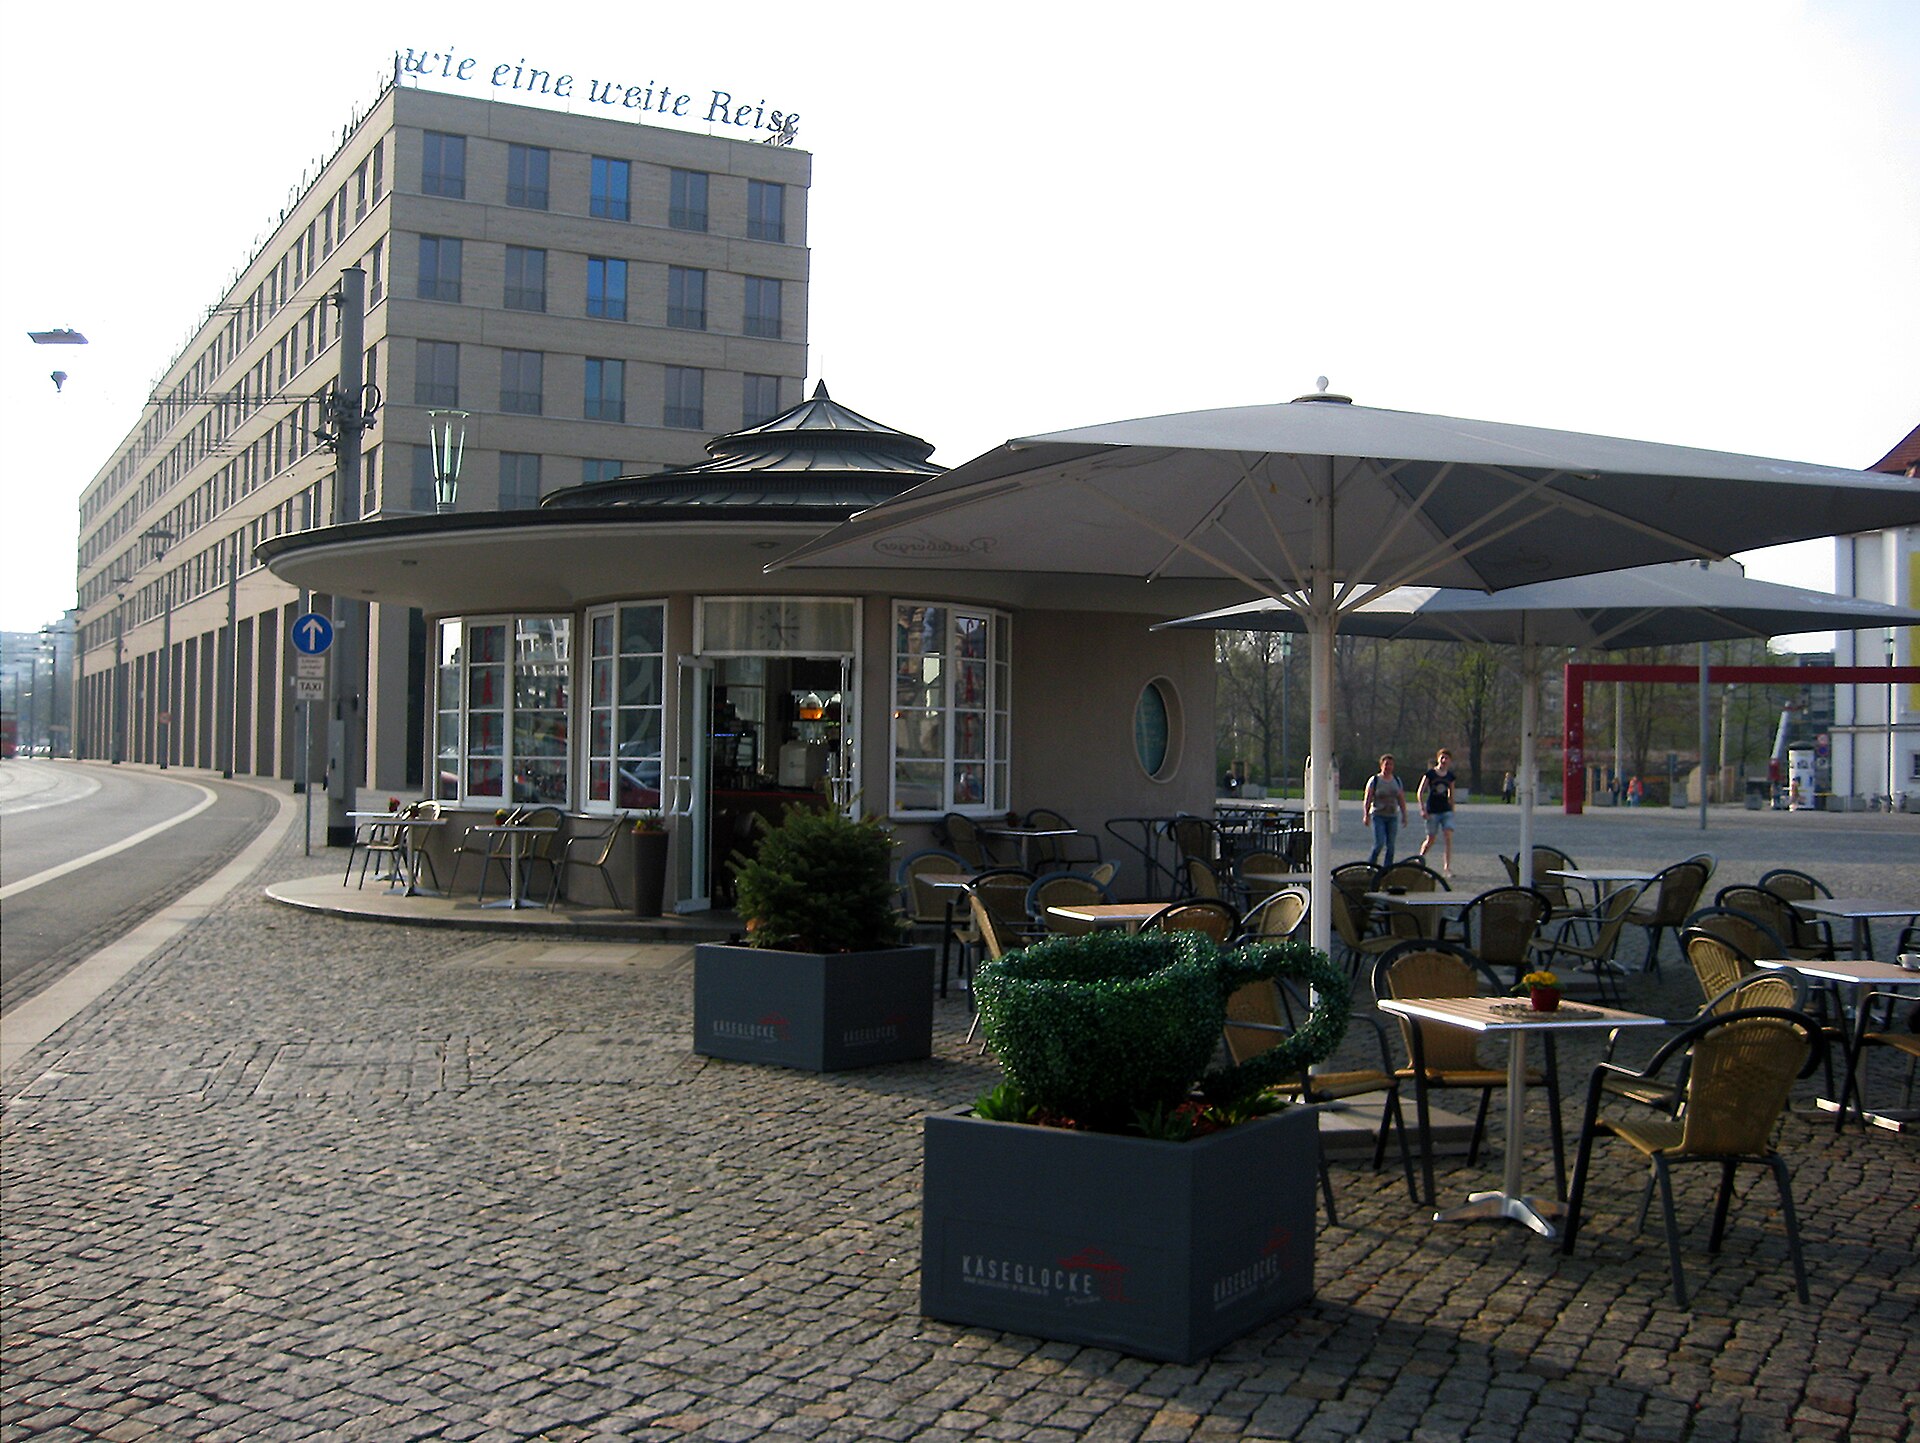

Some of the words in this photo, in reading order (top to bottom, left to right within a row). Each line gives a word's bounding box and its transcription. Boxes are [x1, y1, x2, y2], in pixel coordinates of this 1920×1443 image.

[405, 46, 476, 80] wie
[491, 58, 573, 97] eine
[589, 79, 690, 116] weite
[703, 90, 800, 133] Reise
[300, 682, 321, 692] TAXI
[962, 1254, 1092, 1294] KÄSEGLOCKE
